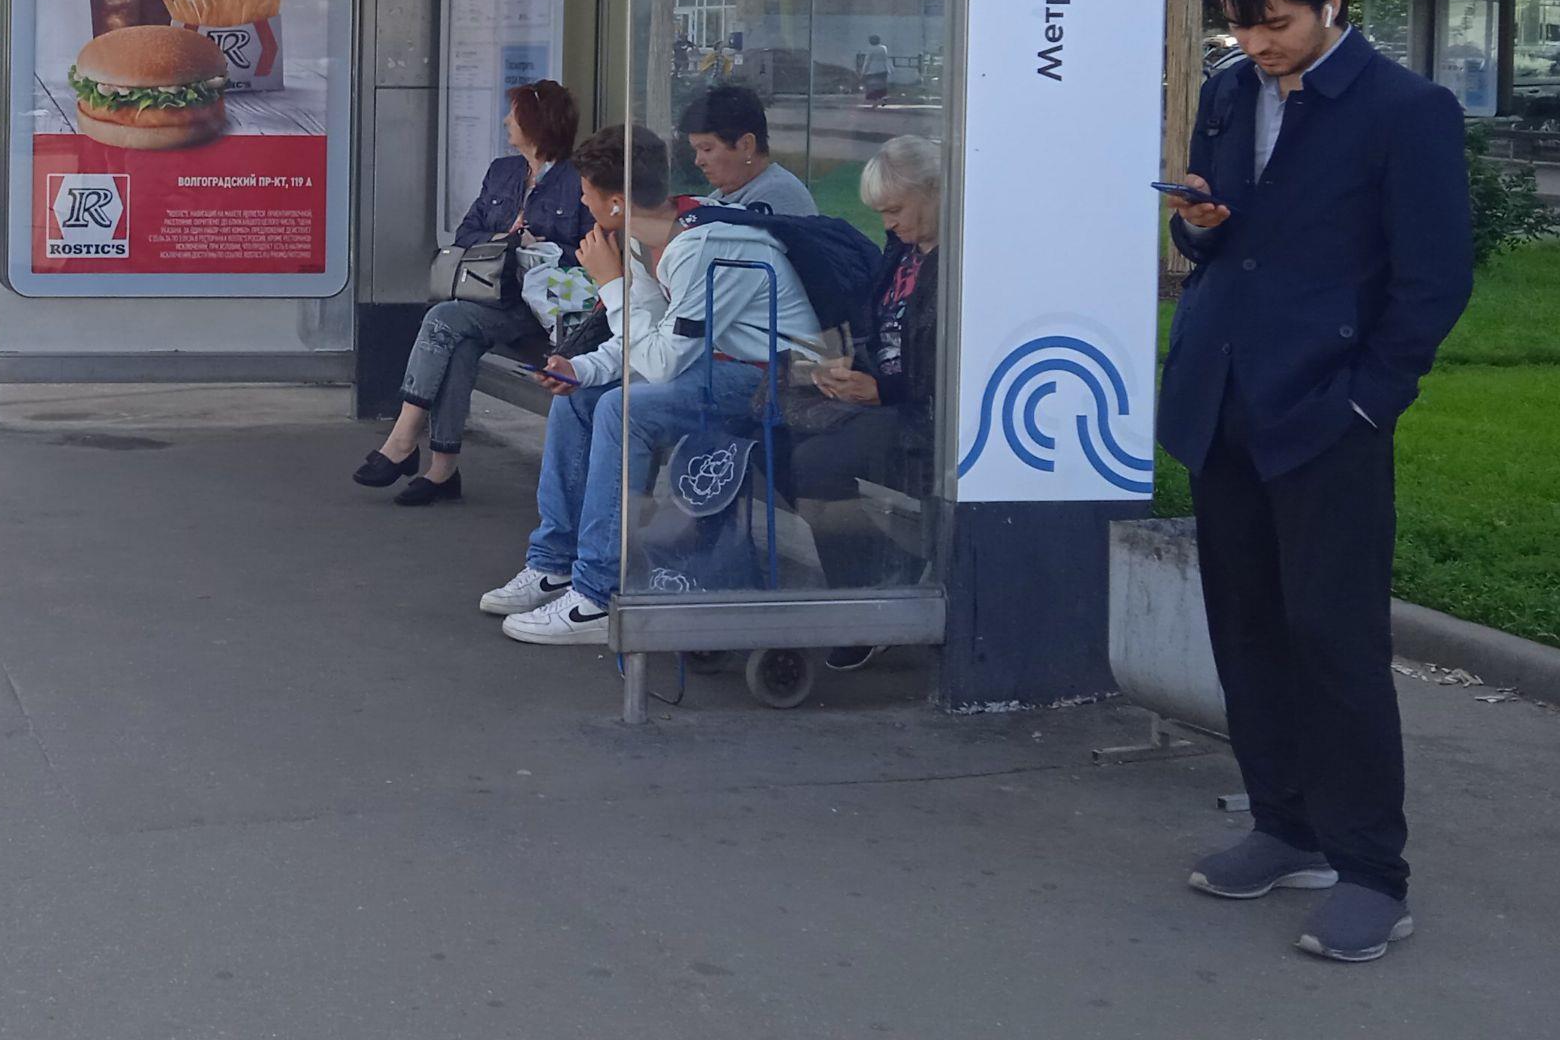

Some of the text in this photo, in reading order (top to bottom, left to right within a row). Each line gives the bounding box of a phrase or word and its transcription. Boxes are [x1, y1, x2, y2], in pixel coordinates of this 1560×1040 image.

[177, 173, 313, 189] ВОЛГОГРАДСКИЙ ПР-КТ, 119 А
[49, 243, 126, 255] ROSTIC'S
